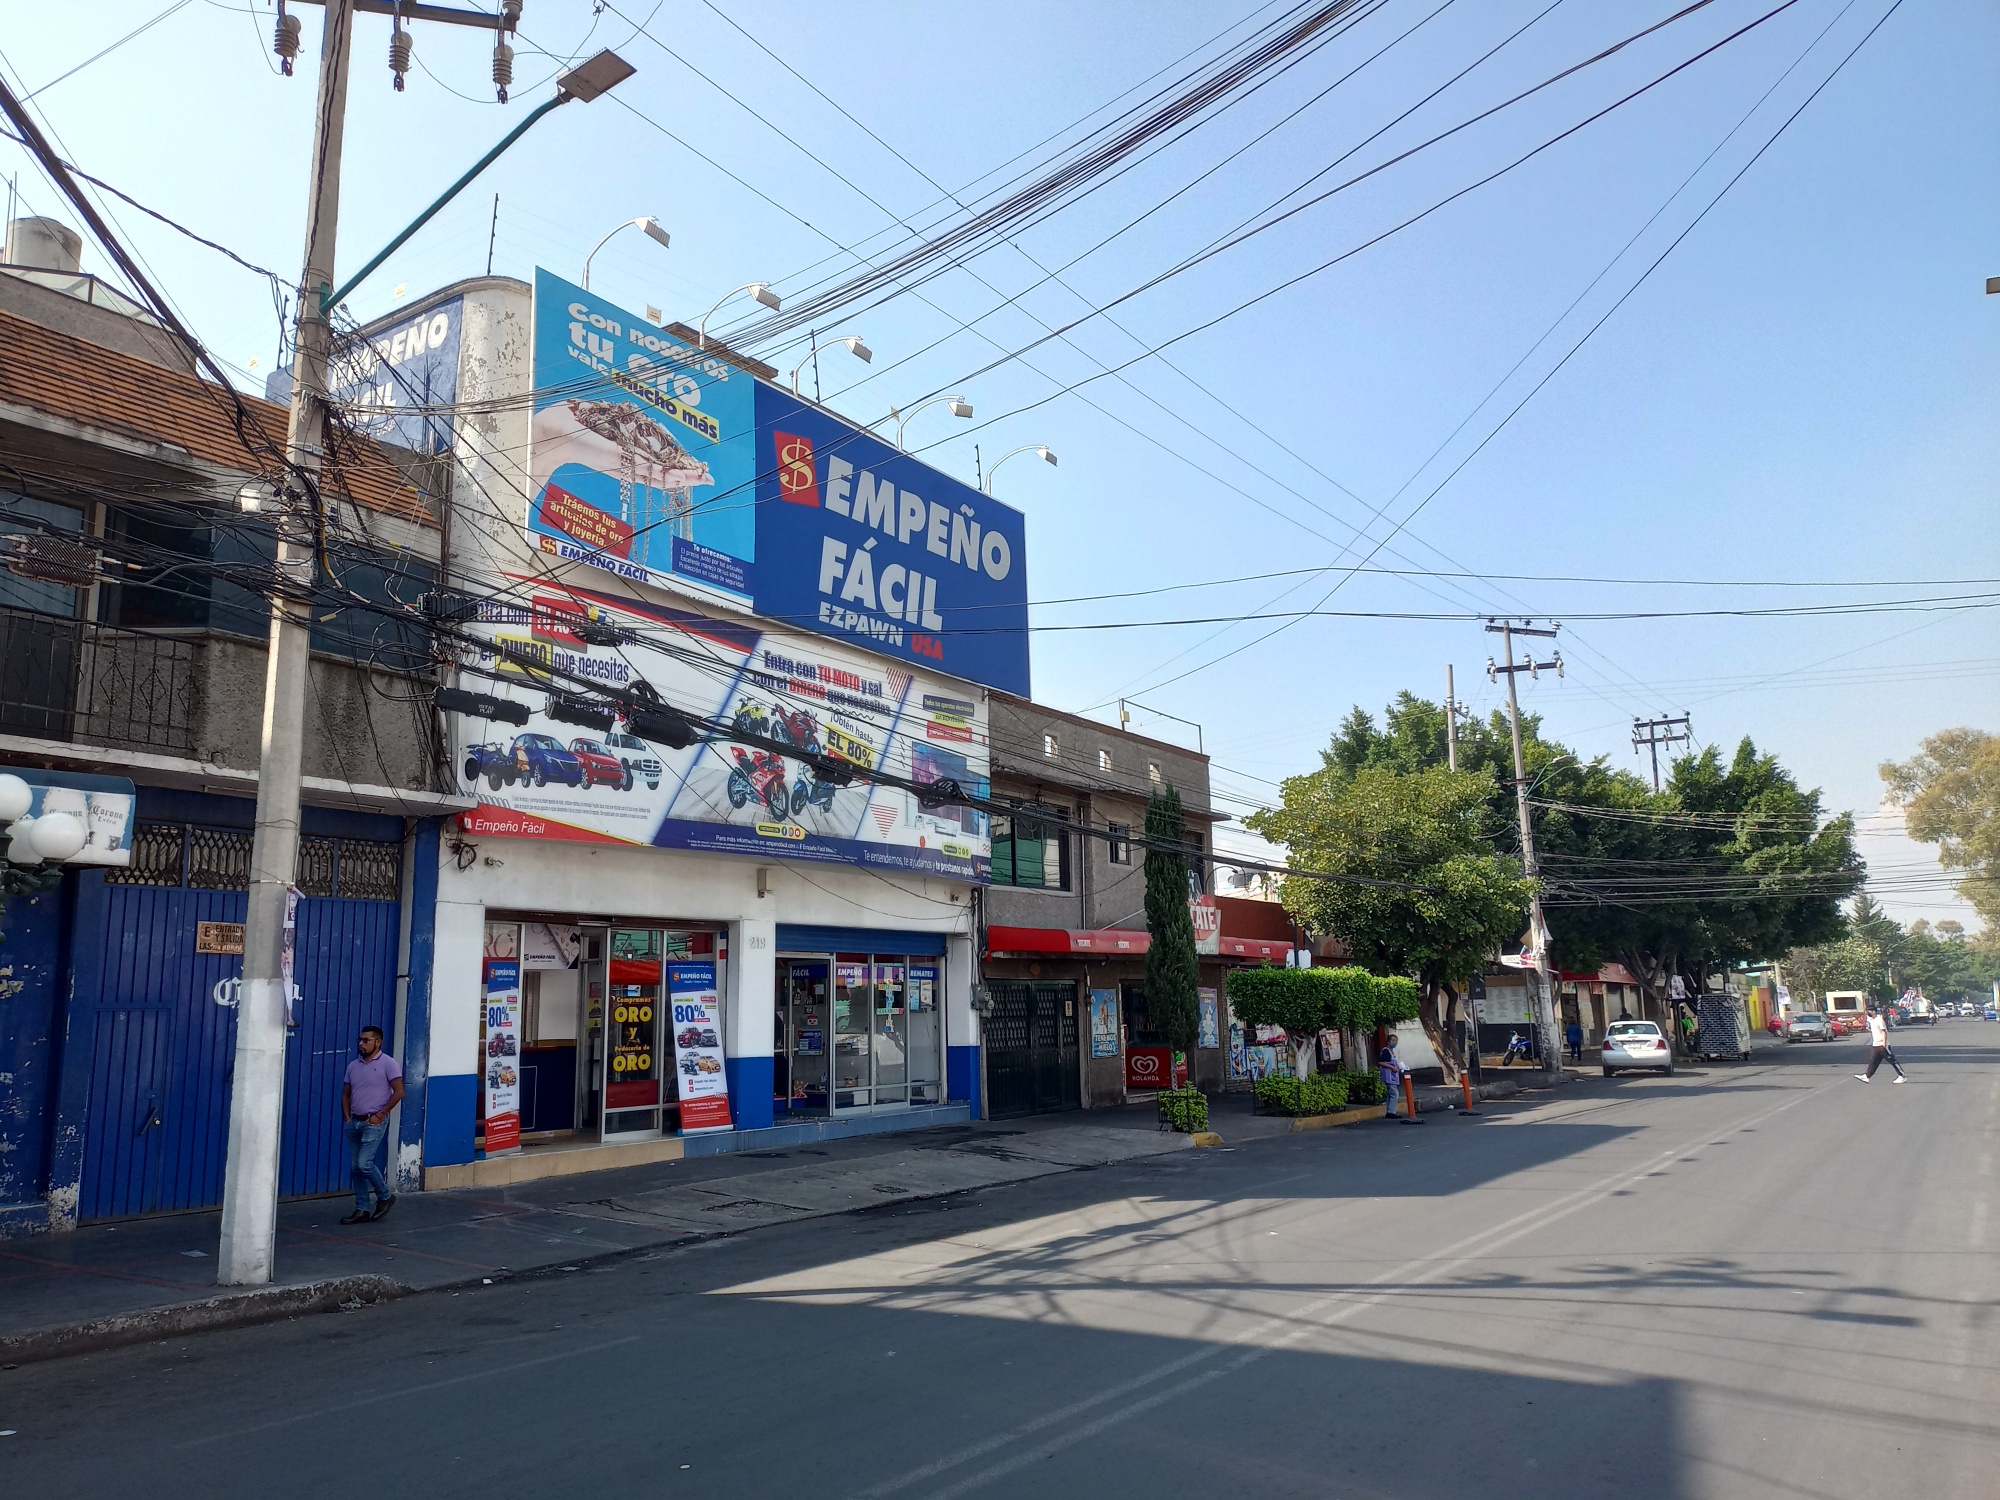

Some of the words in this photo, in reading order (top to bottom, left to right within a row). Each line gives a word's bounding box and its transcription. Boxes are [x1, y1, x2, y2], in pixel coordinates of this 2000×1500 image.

[567, 302, 621, 337] Con
[568, 322, 614, 364] tu
[627, 353, 701, 407] oro
[567, 345, 610, 376] vale
[615, 371, 677, 416] mucho
[682, 415, 718, 441] más
[562, 493, 600, 521] Tráenos
[601, 513, 617, 529] tus
[825, 454, 1011, 581] EMPEÑO
[563, 519, 570, 531] y
[595, 522, 607, 536] de
[818, 536, 943, 633] FÁCIL
[477, 599, 502, 623] ntra
[818, 601, 904, 648] EZPAWN
[911, 631, 943, 661] USA
[578, 657, 629, 683] necesitas
[764, 650, 794, 674] Entra
[795, 662, 816, 679] con
[817, 665, 831, 683] TU
[833, 669, 860, 691] MOTO
[861, 679, 868, 693] y
[868, 681, 882, 698] sal
[753, 673, 775, 687] con
[776, 675, 787, 690] el
[788, 678, 826, 699] DINERO
[855, 723, 874, 745] hasta
[827, 729, 844, 752] EL
[846, 740, 873, 768] 80%
[92, 804, 123, 820] Corona
[475, 819, 518, 834] Empeño
[520, 820, 545, 834] Fácil
[863, 850, 870, 862] Te
[870, 852, 904, 867] entendemos,
[903, 857, 909, 866] te
[909, 858, 933, 870] ayudamos
[936, 861, 941, 870] te
[215, 924, 244, 935] ENTRADA
[215, 935, 220, 943] Y
[220, 934, 244, 944] SALIDA
[199, 942, 212, 951] LAS
[680, 971, 700, 979] EMPEÑO
[700, 972, 712, 980] FÁCIL
[792, 968, 810, 977] FÁCIL
[837, 967, 863, 977] EMPEÑO
[910, 969, 934, 978] REMATES
[616, 996, 651, 1004] Compramos
[488, 1006, 509, 1028] 80%
[614, 1006, 653, 1023] ORO
[674, 1004, 706, 1023] 80%
[629, 1026, 638, 1040] y
[1094, 1034, 1117, 1042] TENEMOS
[612, 1053, 651, 1072] ORO
